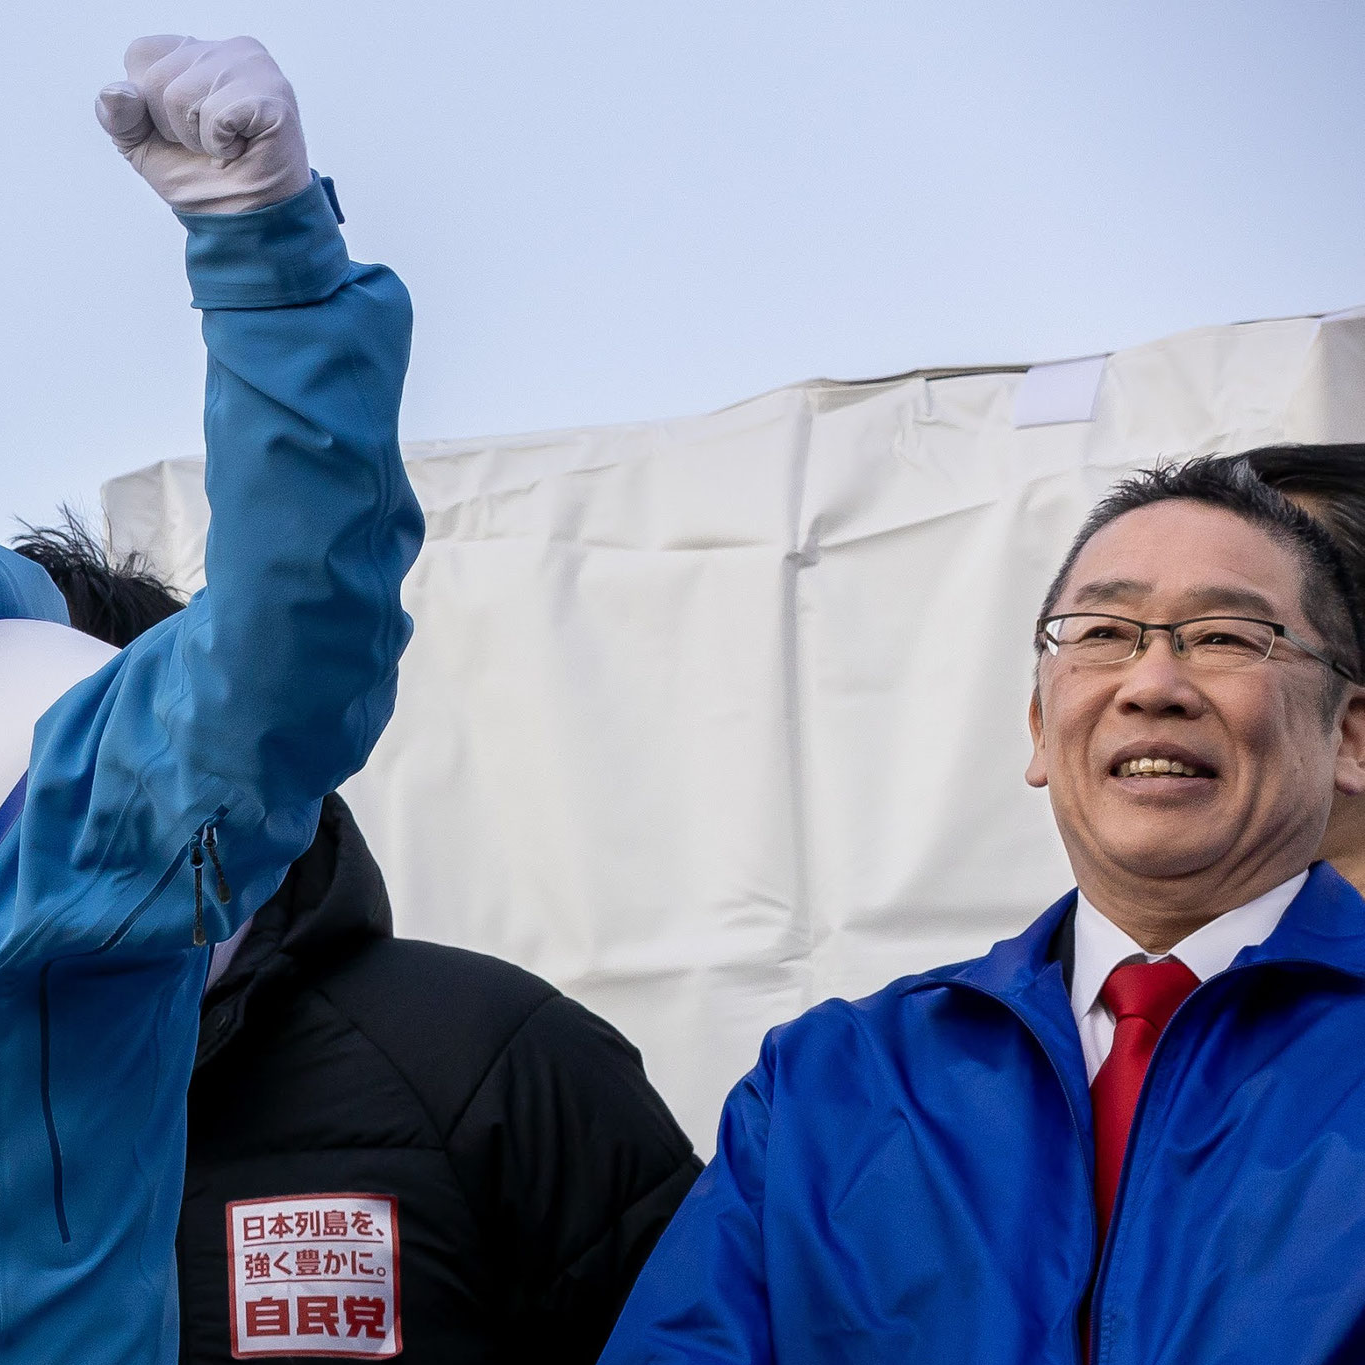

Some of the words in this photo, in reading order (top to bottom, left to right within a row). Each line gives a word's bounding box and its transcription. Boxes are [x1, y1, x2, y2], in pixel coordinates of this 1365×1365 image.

[243, 1209, 384, 1241] 日本列島を、
[244, 1249, 386, 1280] 強く豊かに。
[245, 1296, 386, 1339] 自民党
